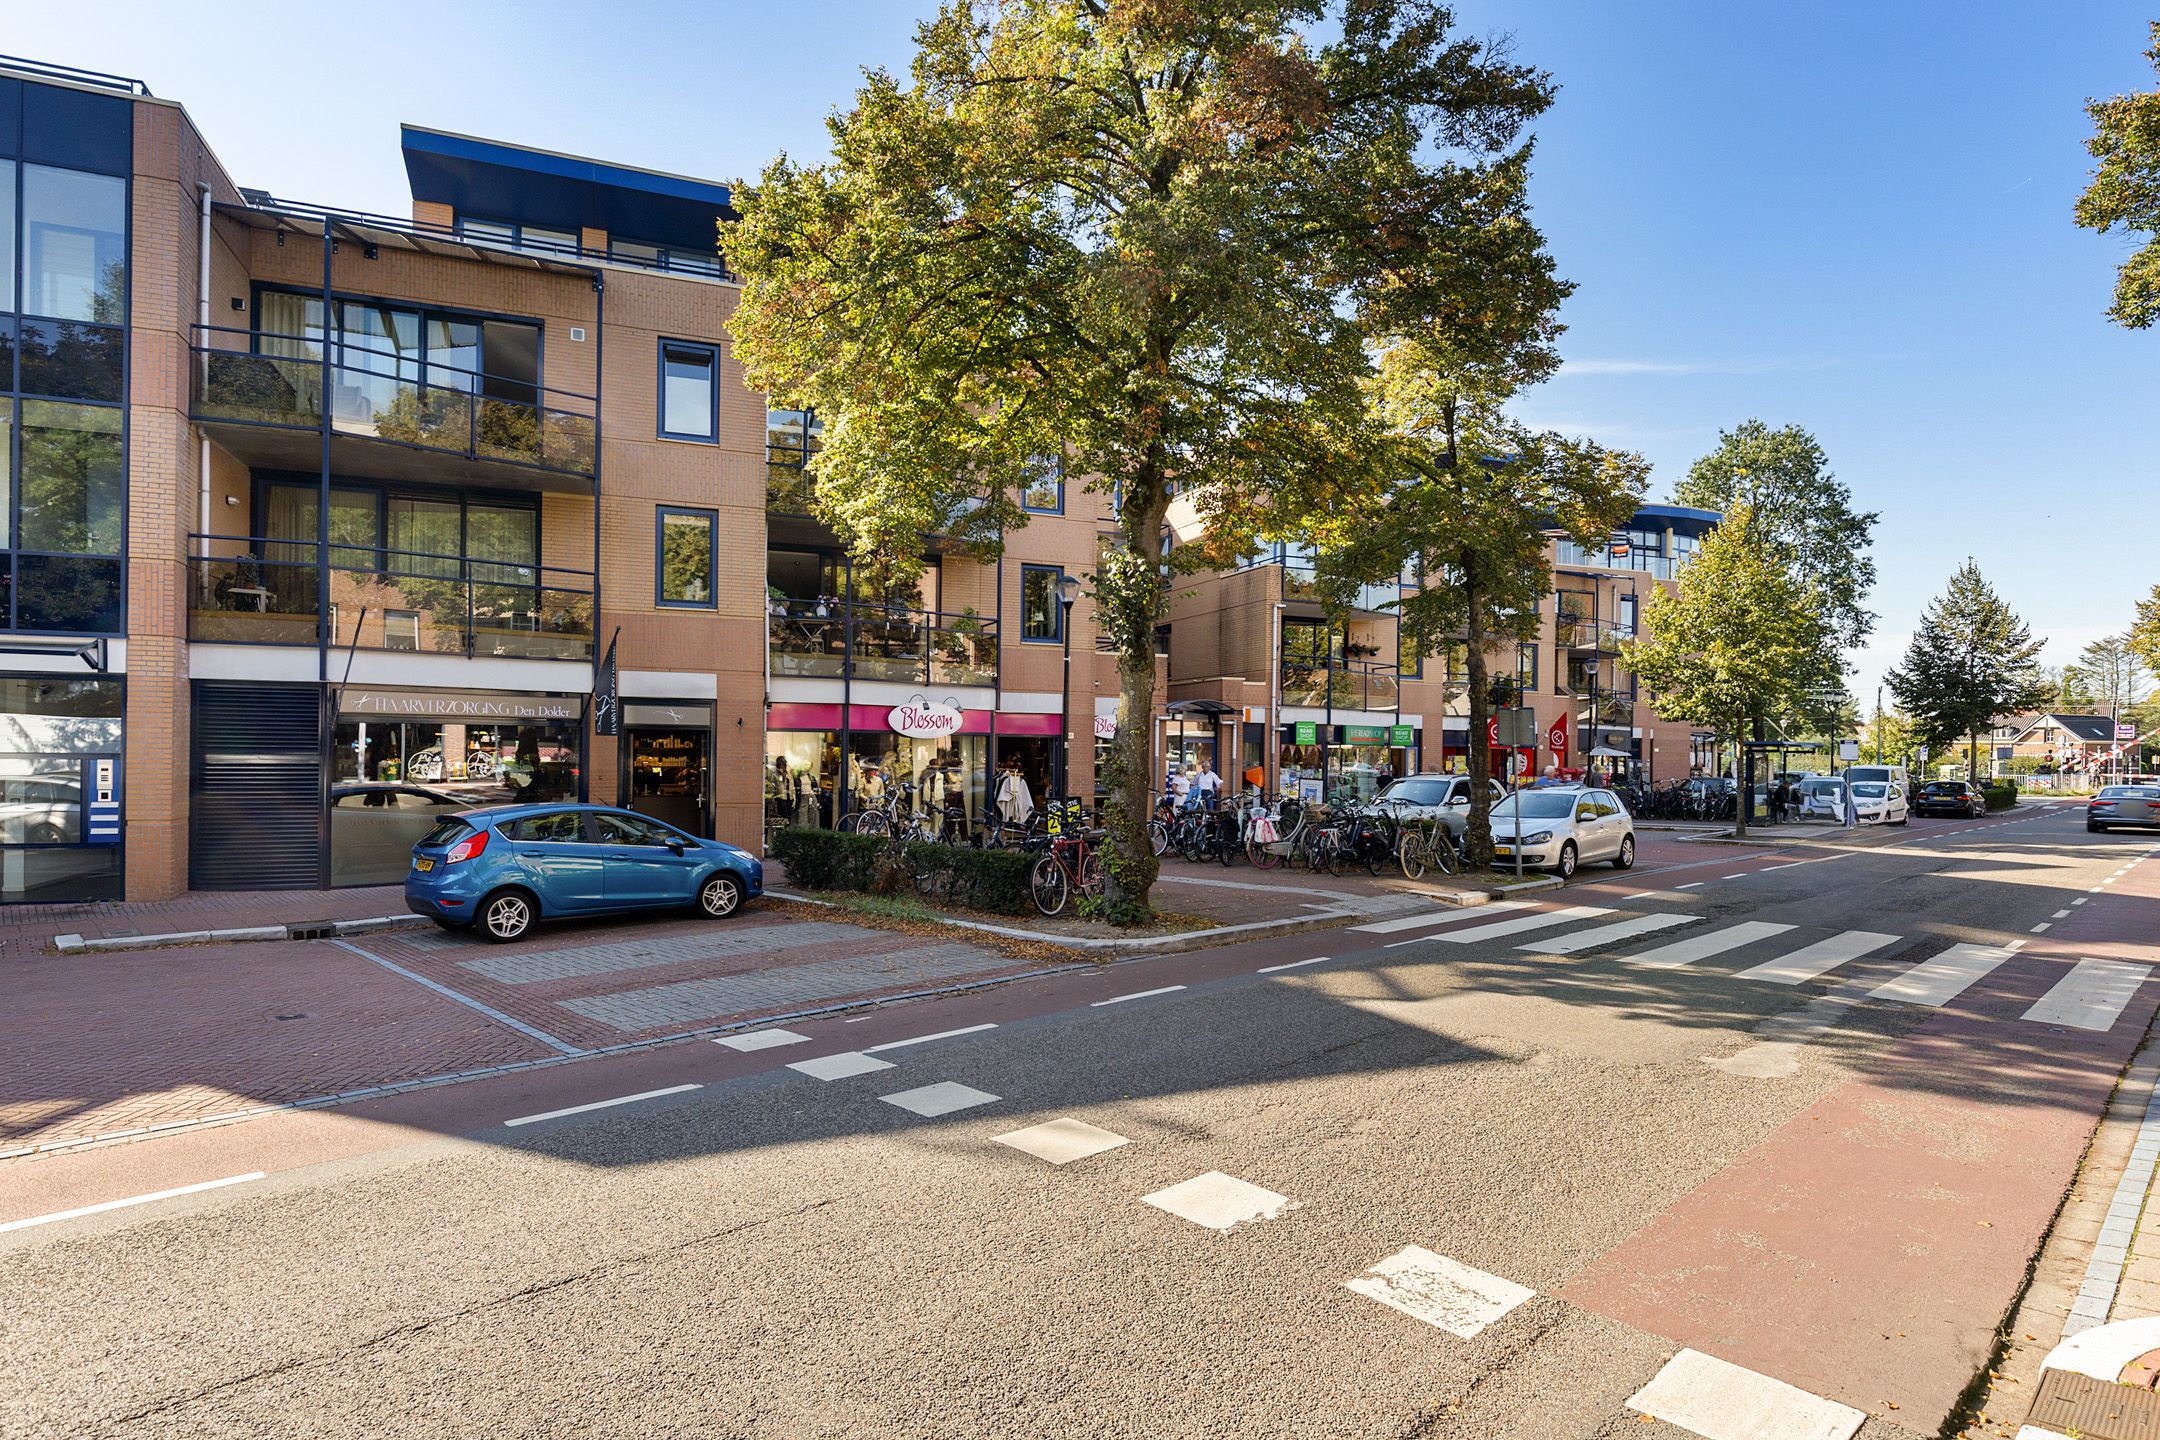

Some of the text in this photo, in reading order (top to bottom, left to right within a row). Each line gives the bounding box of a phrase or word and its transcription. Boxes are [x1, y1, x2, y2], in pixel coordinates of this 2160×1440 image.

[375, 698, 570, 717] HAARVERZORGING Den Dolder
[900, 706, 953, 730] Blossom
[1095, 717, 1116, 733] Blos
